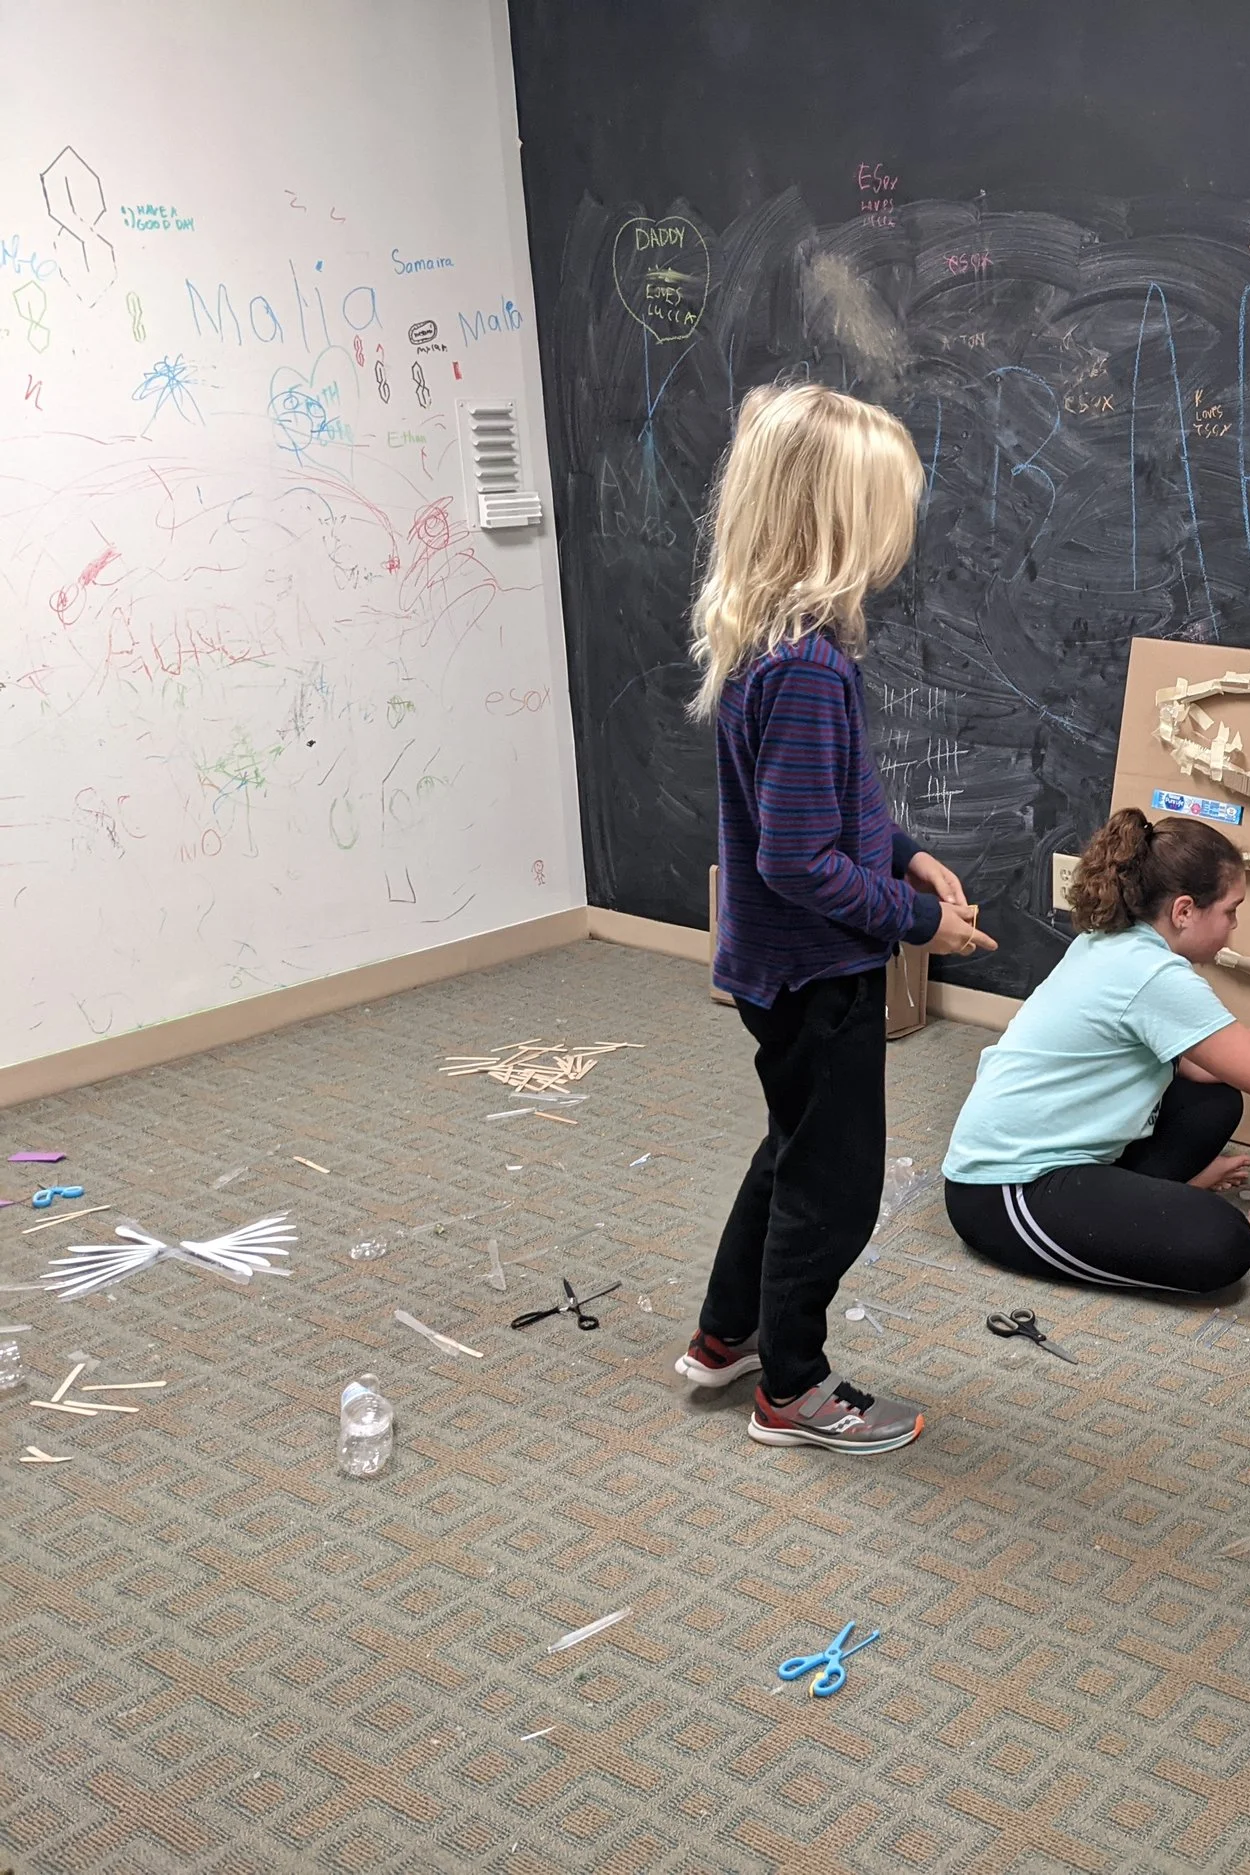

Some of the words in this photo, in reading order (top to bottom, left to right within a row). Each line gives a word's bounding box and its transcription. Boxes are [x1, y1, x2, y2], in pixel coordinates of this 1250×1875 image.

[136, 218, 171, 231] GOOD
[635, 226, 685, 251] DADDY
[391, 248, 454, 275] Samaira
[185, 258, 384, 353] Malia
[457, 296, 523, 348] Malia
